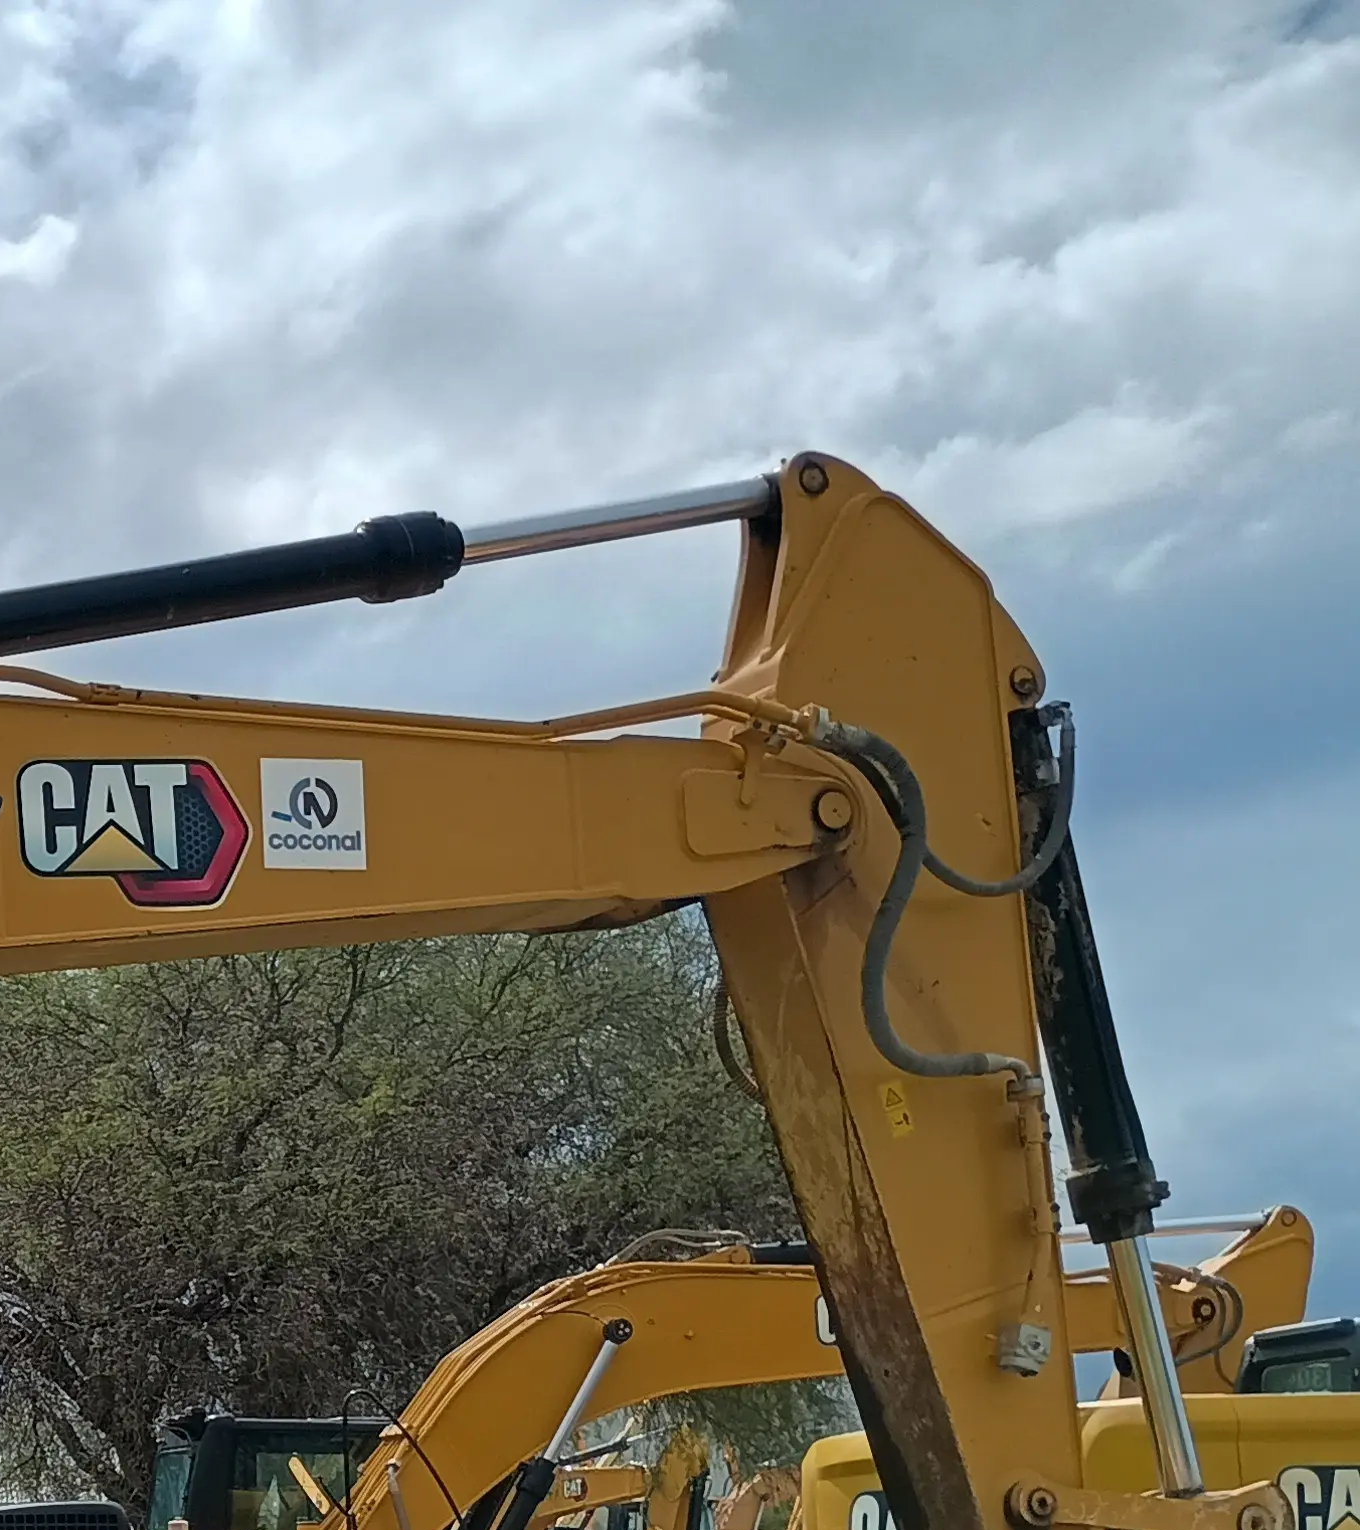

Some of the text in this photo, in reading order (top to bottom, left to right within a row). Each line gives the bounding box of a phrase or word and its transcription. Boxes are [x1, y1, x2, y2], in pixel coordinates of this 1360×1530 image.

[20, 762, 188, 872] CAT
[268, 830, 362, 851] coconal
[563, 1478, 582, 1498] CAT
